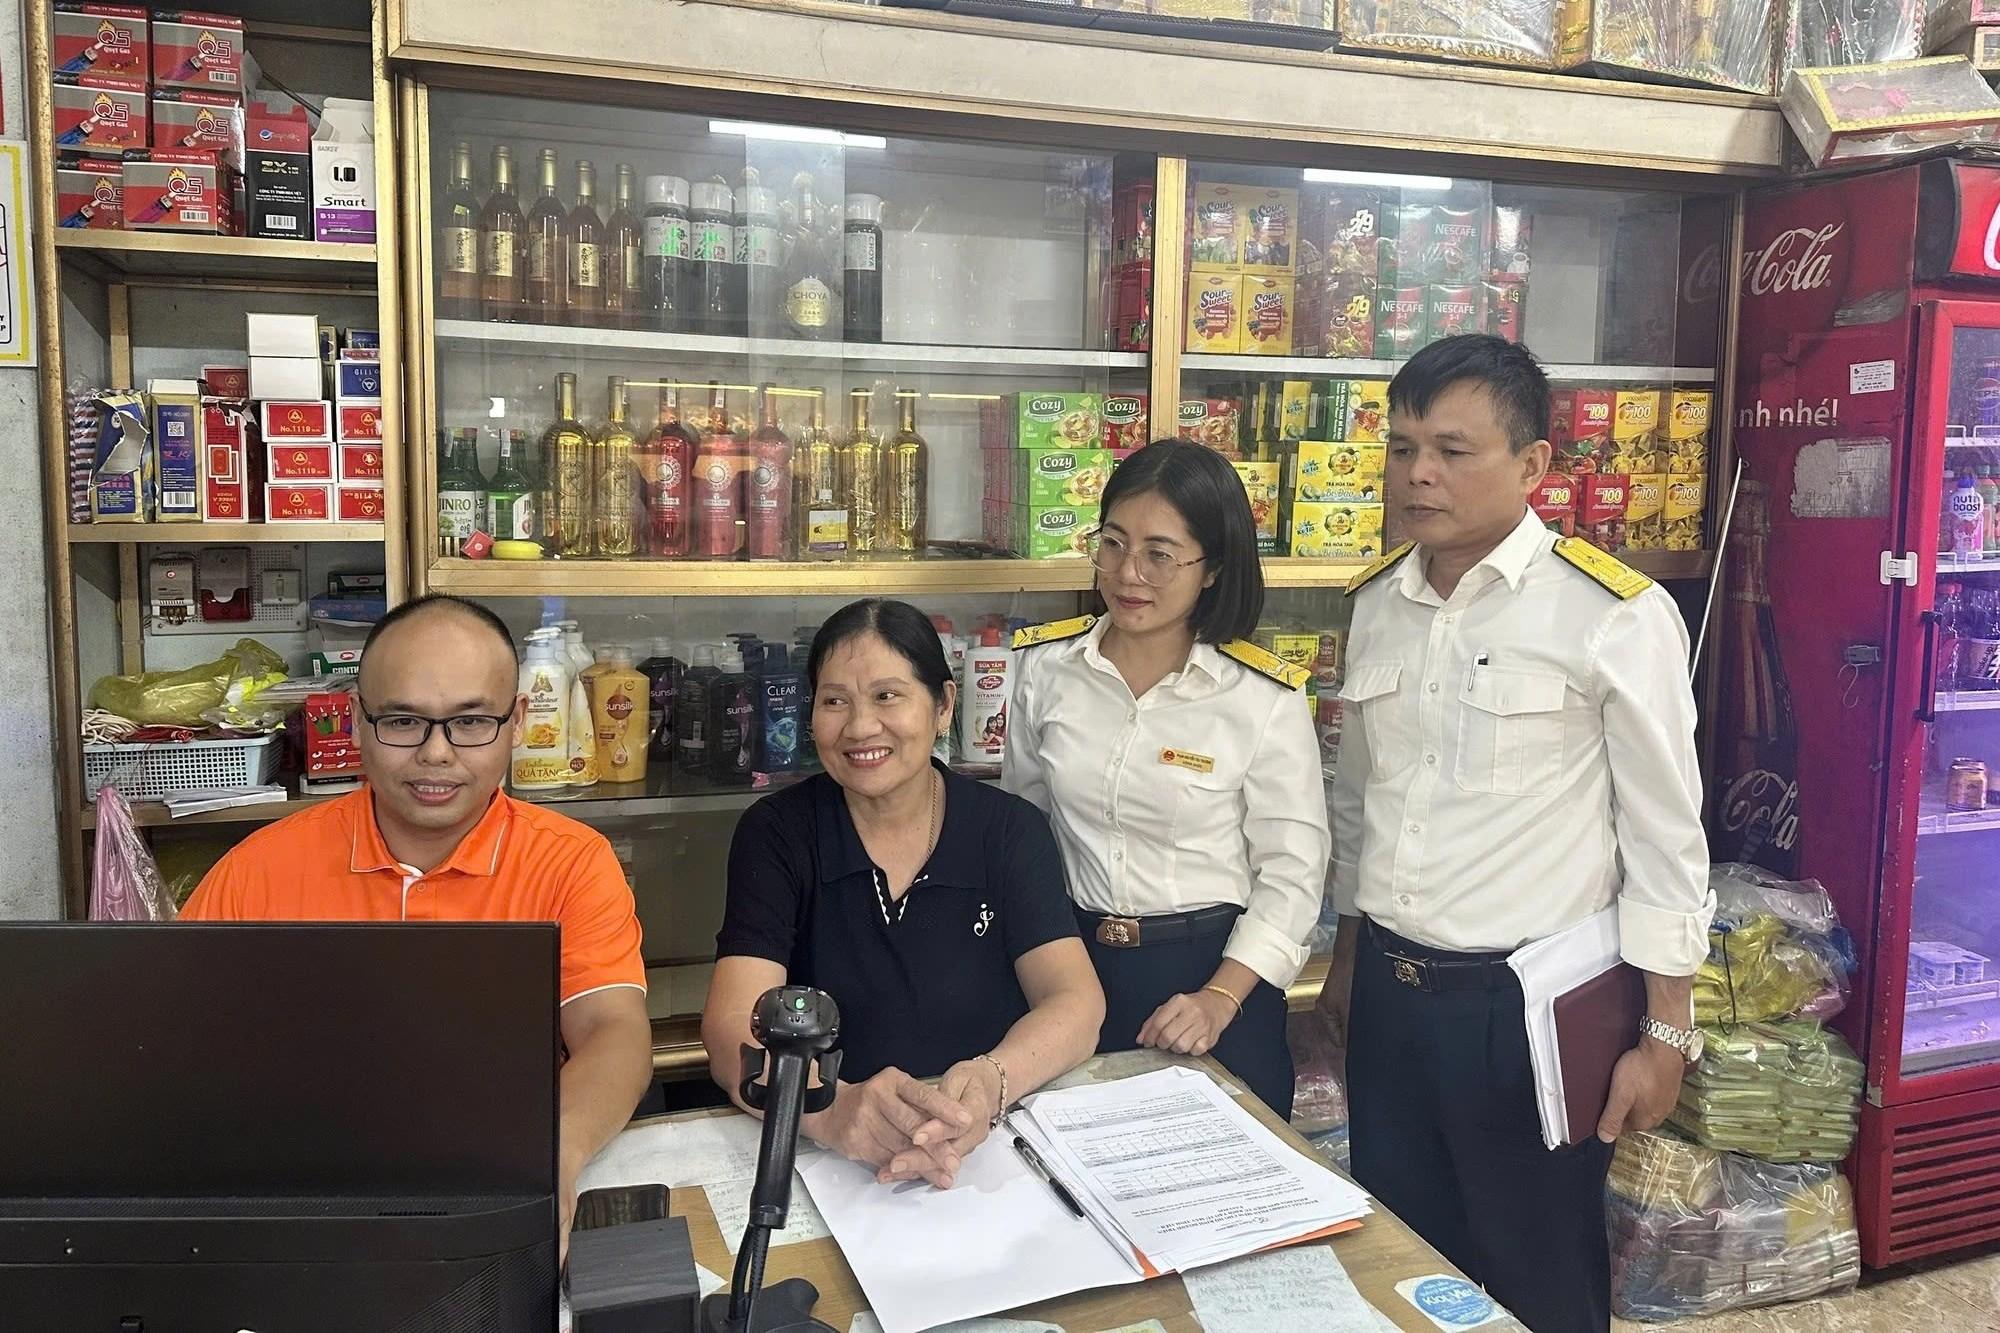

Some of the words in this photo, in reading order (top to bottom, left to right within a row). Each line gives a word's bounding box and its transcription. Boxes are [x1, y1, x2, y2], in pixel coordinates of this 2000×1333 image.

[320, 196, 366, 207] Smart
[794, 291, 826, 300] CHOYA
[1032, 400, 1061, 414] Cozy
[1107, 402, 1136, 414] Cozy
[1590, 404, 1608, 419] 100
[1633, 406, 1651, 418] 100
[1690, 406, 1706, 418] 100
[1778, 398, 1839, 427] nhé!
[1043, 456, 1072, 469] Cozy
[1549, 488, 1570, 504] 100
[1602, 488, 1624, 504] 100
[1641, 488, 1658, 500] 100
[1682, 488, 1700, 500] 100
[1954, 501, 1980, 512] boost
[1043, 512, 1073, 525] Cozy
[650, 688, 679, 698] sunsilk
[767, 685, 796, 696] CLEAR
[604, 702, 633, 712] sunsilk
[726, 704, 754, 716] sunsilk
